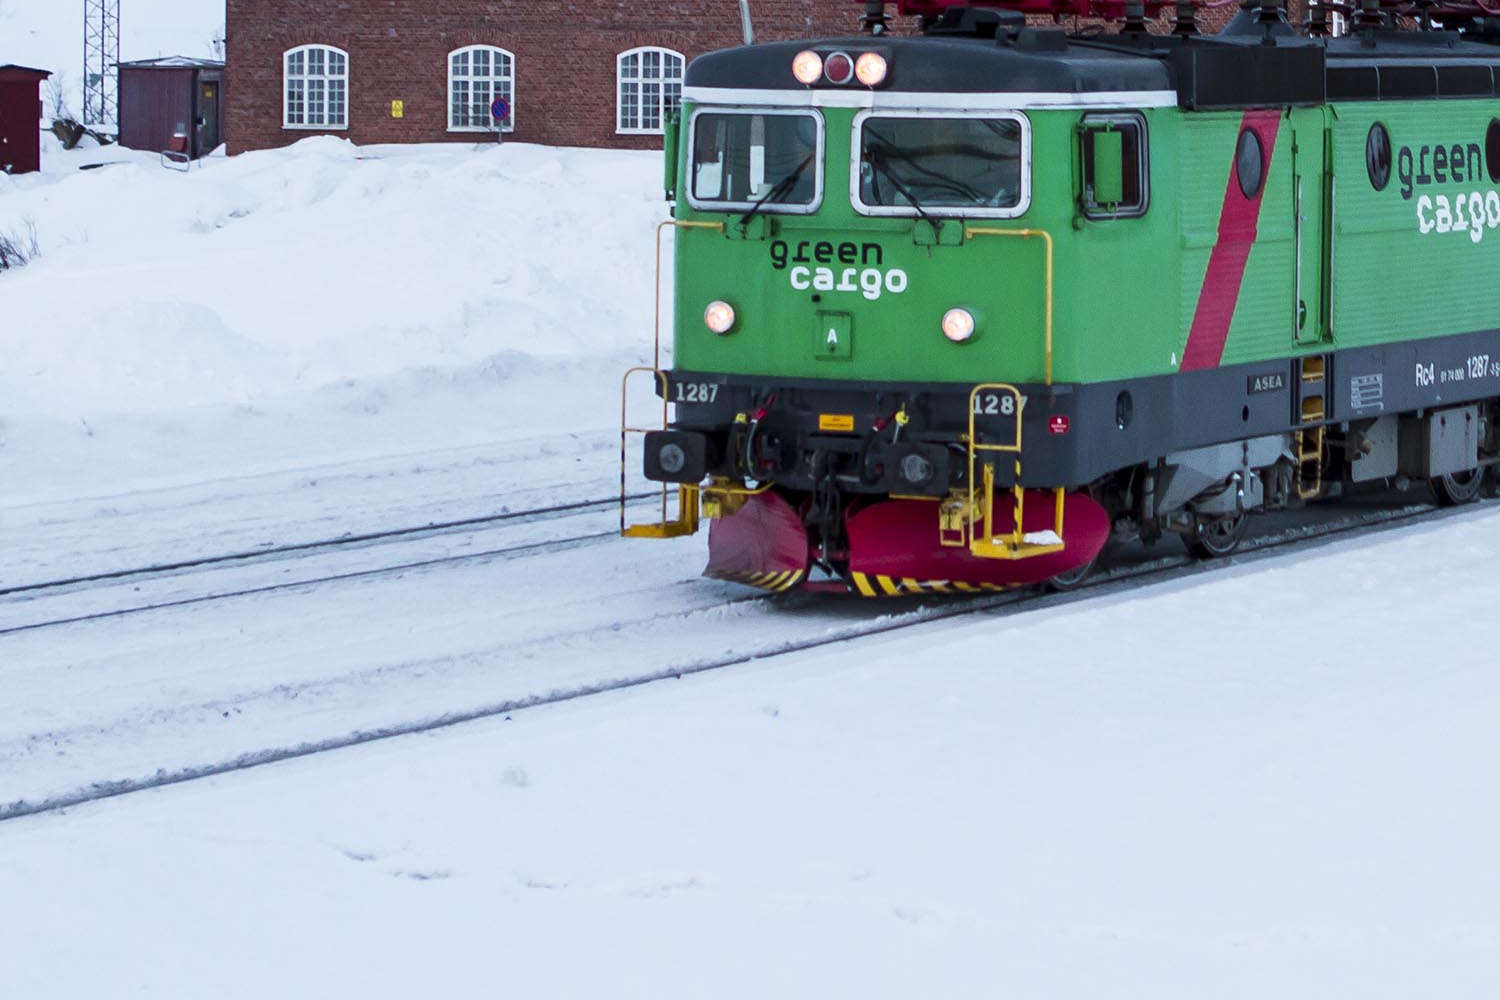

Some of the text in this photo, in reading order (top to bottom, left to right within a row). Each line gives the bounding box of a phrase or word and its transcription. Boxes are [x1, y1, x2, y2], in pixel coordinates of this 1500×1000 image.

[1398, 143, 1482, 200] green
[769, 240, 883, 270] green
[790, 266, 907, 300] cargo
[826, 328, 838, 343] A
[1170, 352, 1177, 366] A
[1415, 362, 1435, 387] Rc4
[1466, 354, 1489, 379] 1287
[676, 382, 719, 403] 1287
[1254, 375, 1283, 392] ASEA
